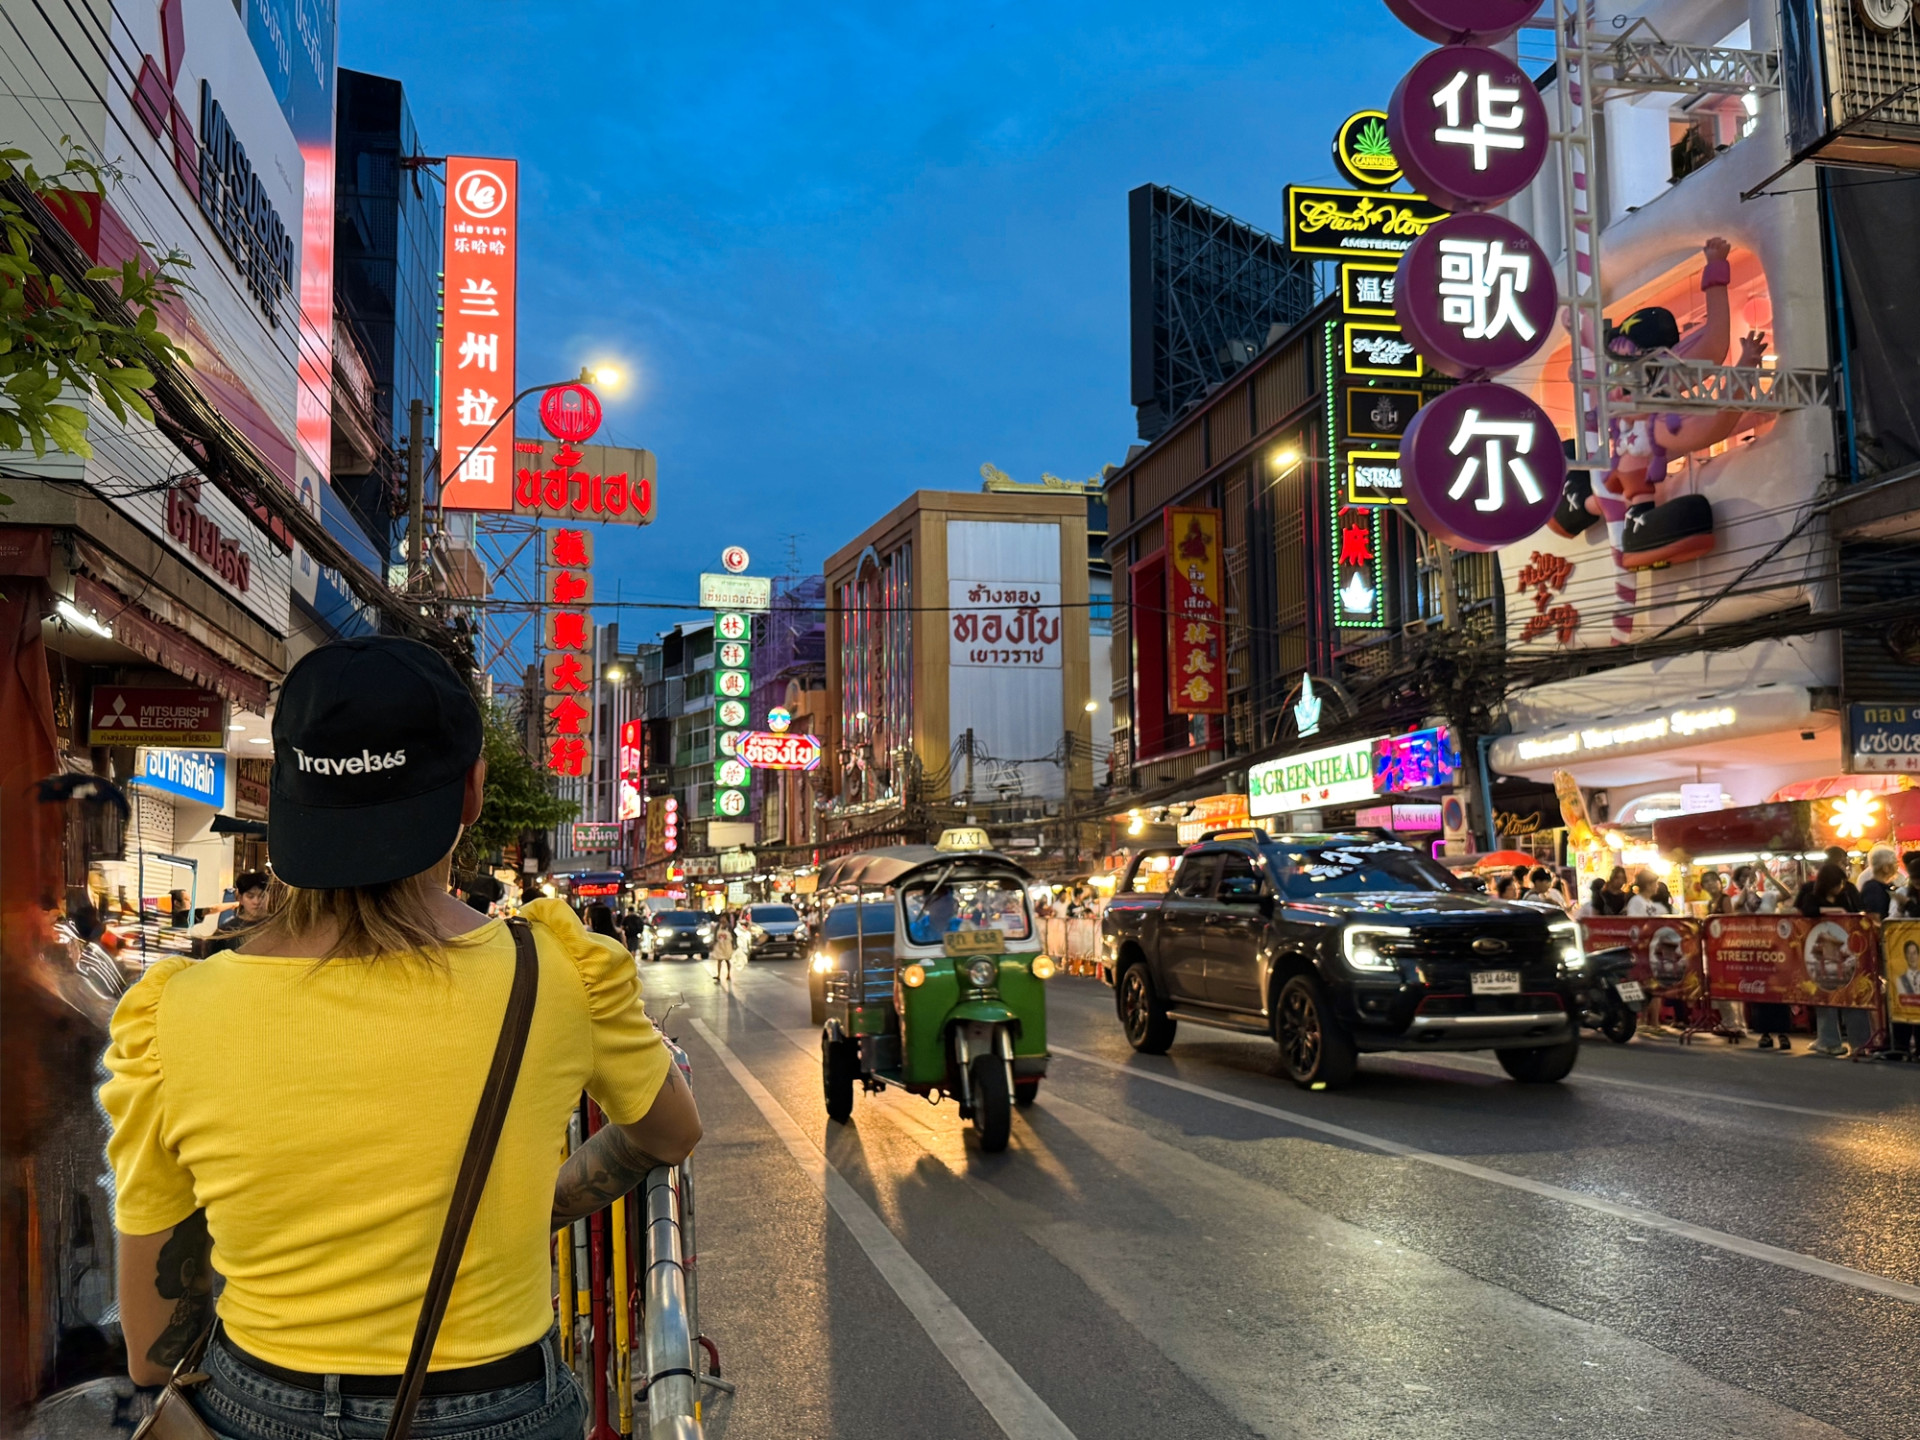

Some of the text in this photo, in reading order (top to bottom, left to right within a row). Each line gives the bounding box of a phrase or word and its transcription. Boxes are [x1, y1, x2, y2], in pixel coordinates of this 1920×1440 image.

[200, 78, 294, 292] MITSUBISHI
[199, 147, 283, 328] ELECTRIC
[454, 237, 506, 256] 乐哈哈
[1432, 70, 1544, 512] 华歌尔
[457, 278, 499, 484] 兰州拉面
[968, 583, 1041, 604] ห้างทอง
[970, 646, 1044, 663] เยาวราช
[140, 706, 209, 718] MITSUBISHI
[1864, 708, 1906, 723] ทอง
[139, 718, 199, 729] ELECTRIC
[293, 746, 406, 775] Travel365
[1263, 751, 1371, 795] GREENHEAD
[948, 833, 981, 845] TAXI
[1716, 950, 1786, 963] STREET FOOD
